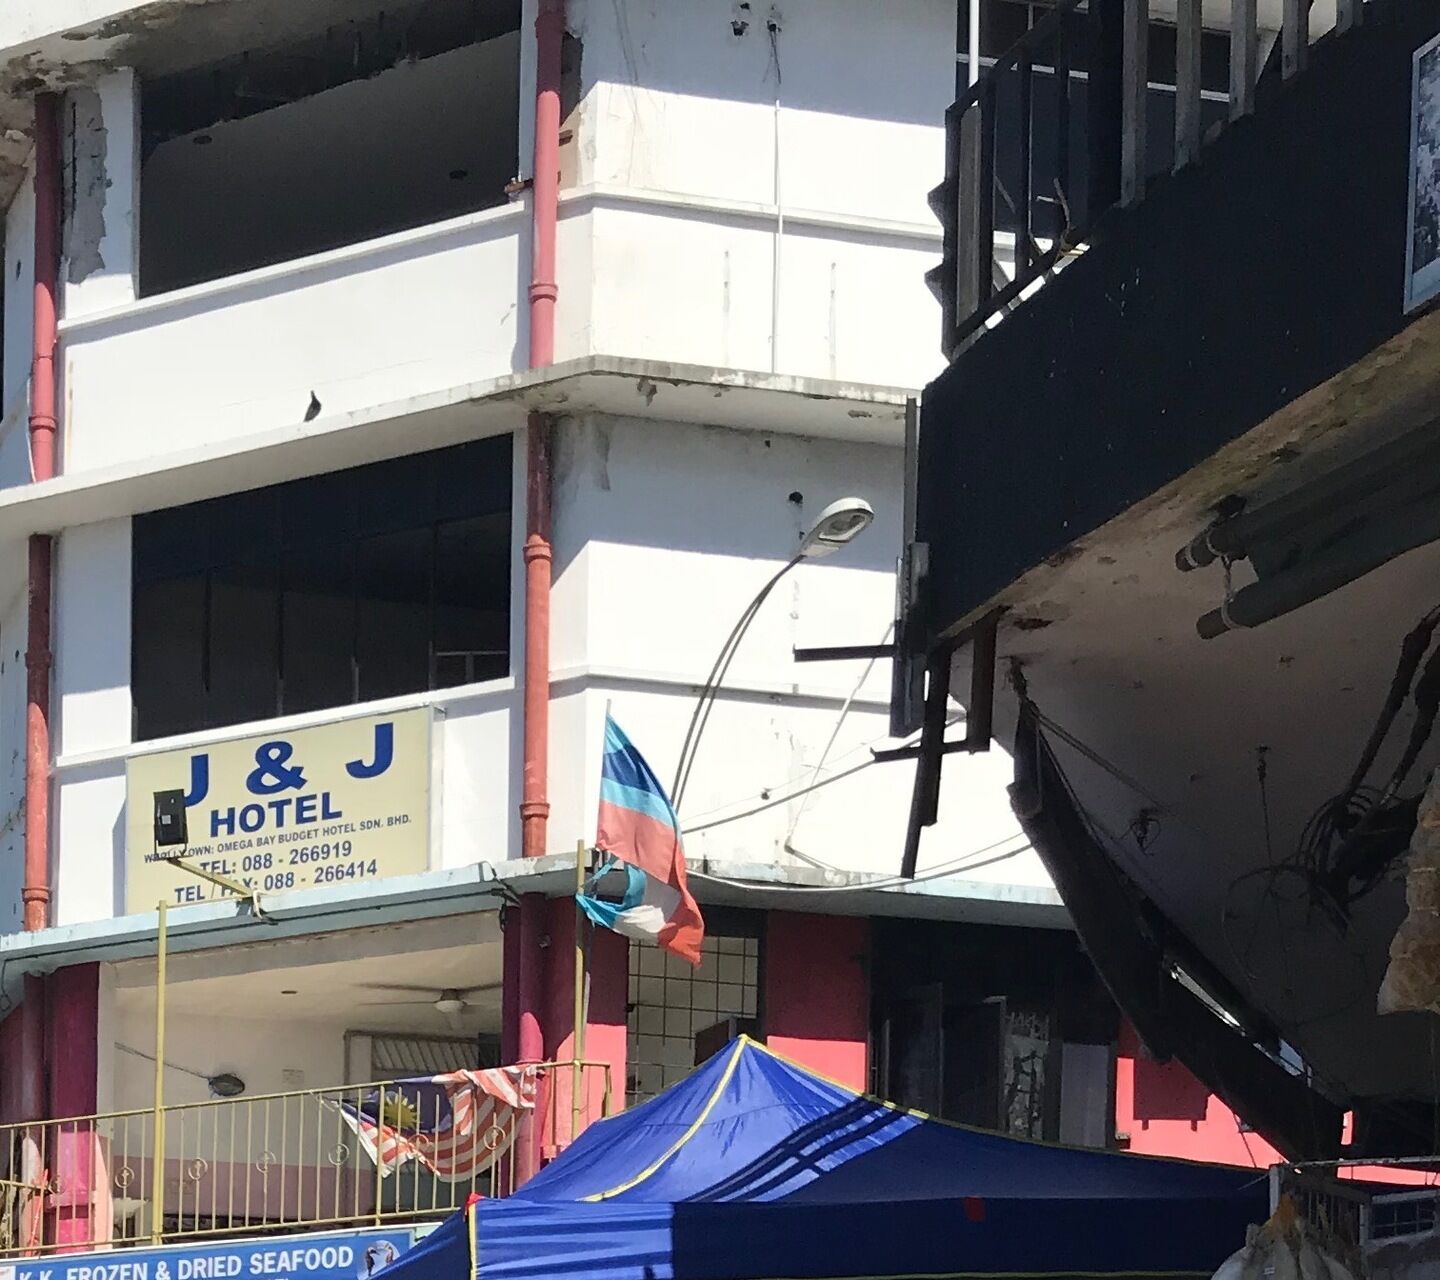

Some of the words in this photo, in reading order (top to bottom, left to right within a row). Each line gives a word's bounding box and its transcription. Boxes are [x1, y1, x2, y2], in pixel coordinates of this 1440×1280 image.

[184, 753, 209, 808] J
[246, 741, 308, 796] &
[345, 722, 394, 779] J
[188, 845, 215, 857] OWN:
[217, 839, 254, 853] OMEGA
[256, 836, 277, 849] BAY
[278, 828, 319, 845] BUDGET
[322, 823, 356, 838] HOTEL
[359, 818, 385, 832] SDN.
[387, 813, 411, 827] BHD.
[210, 791, 343, 838] HOTEL
[200, 859, 236, 876] TEL:
[242, 853, 273, 873] 088
[289, 840, 352, 866] 266919
[174, 884, 206, 904] TEL
[264, 871, 295, 892] 088
[314, 859, 377, 885] 266414
[177, 1254, 242, 1280] DRIED
[249, 1246, 354, 1275] SEAFOOD
